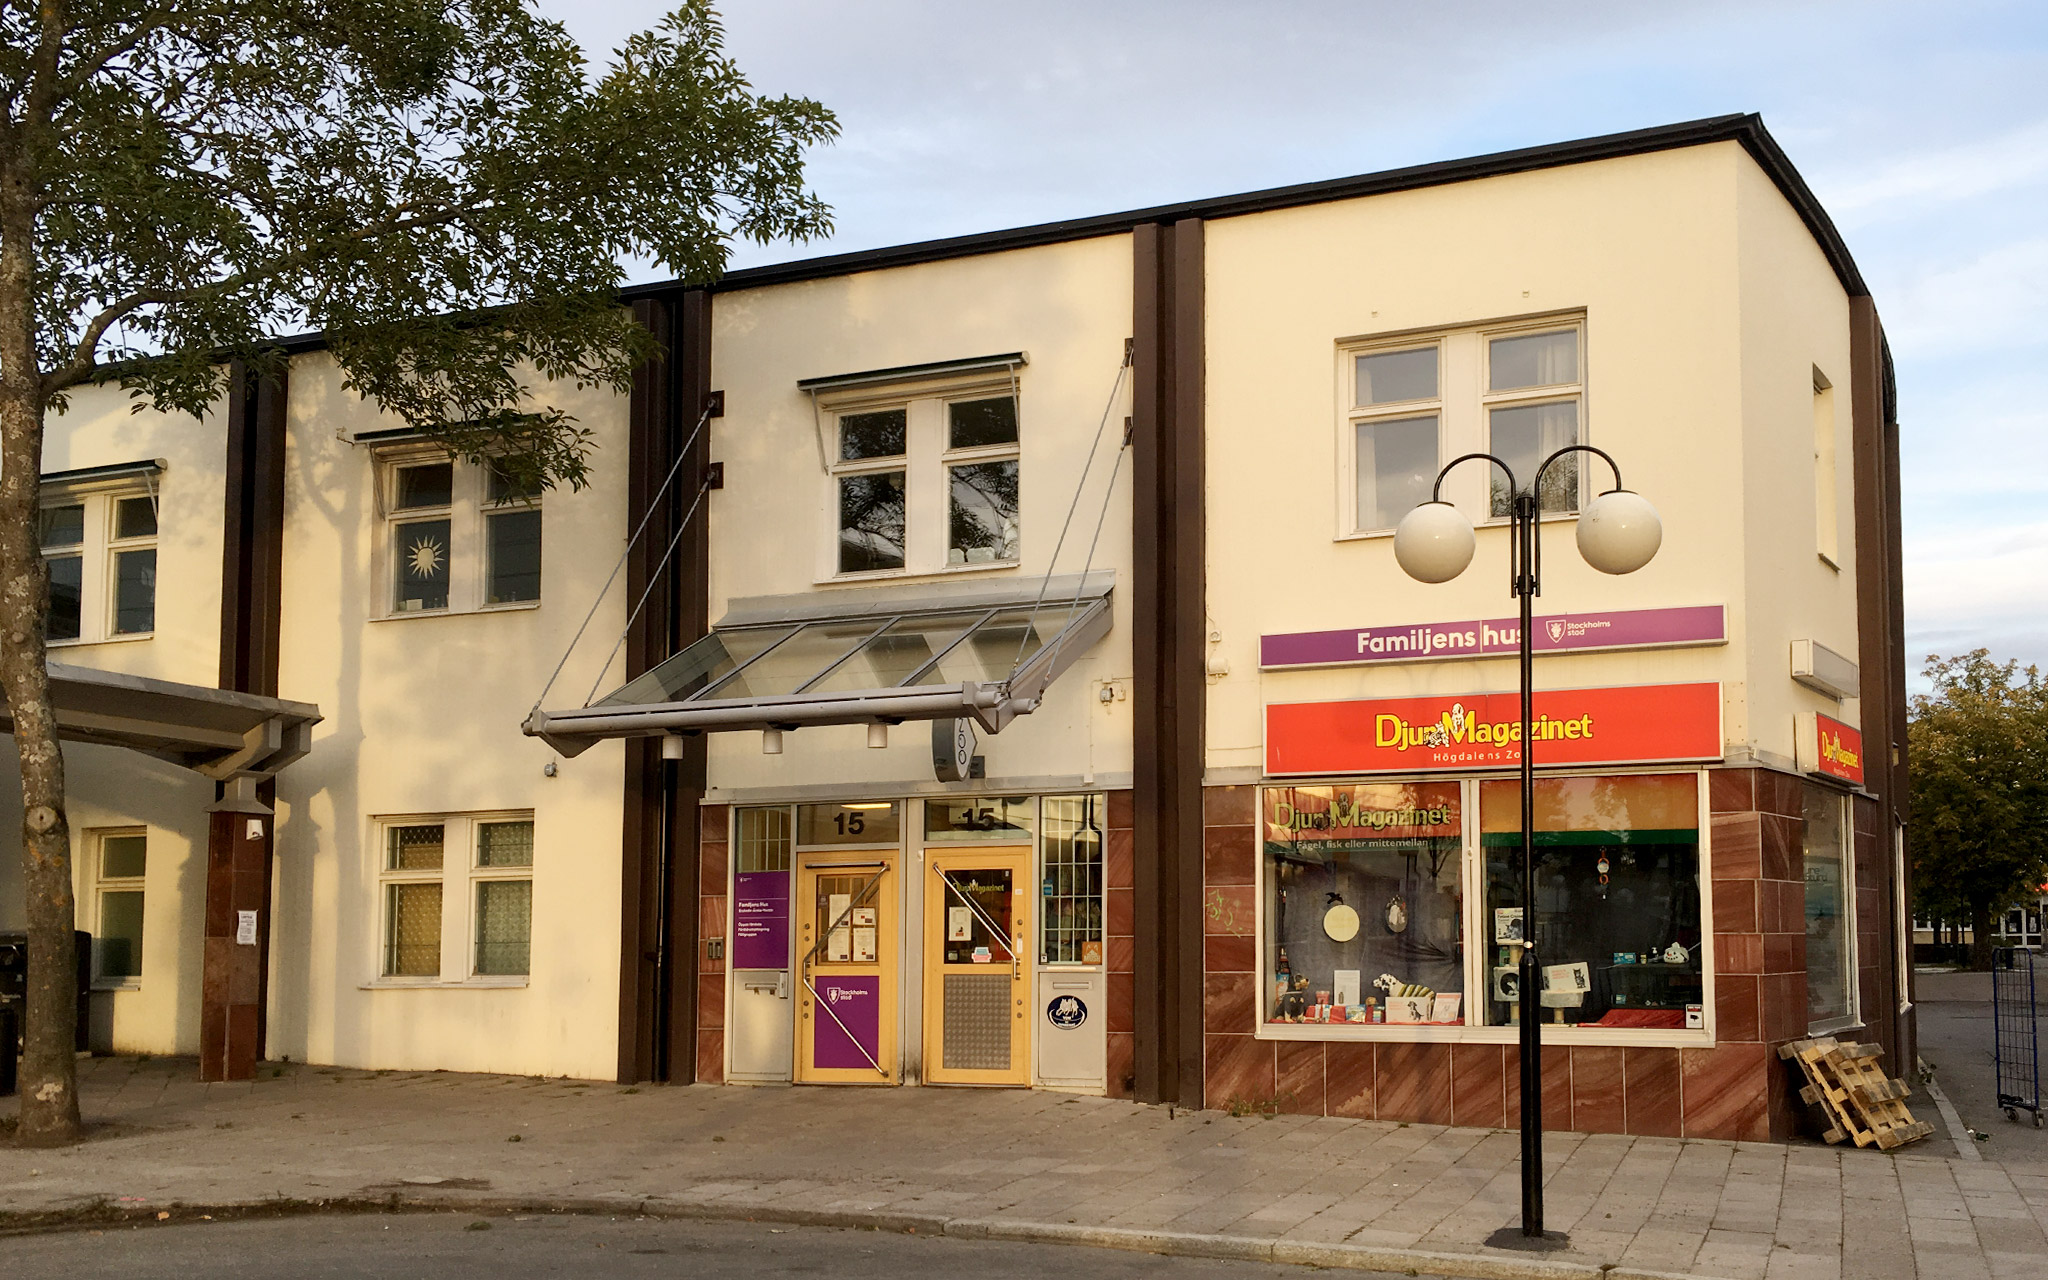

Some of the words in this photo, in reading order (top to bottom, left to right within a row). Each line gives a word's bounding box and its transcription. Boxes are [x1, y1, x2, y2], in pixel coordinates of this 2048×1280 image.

[1566, 620, 1612, 630] Stockholms
[1357, 628, 1477, 655] Familjens
[1433, 751, 1501, 763] Högdalens
[833, 811, 865, 836] 15
[962, 807, 995, 830] 15
[1326, 840, 1343, 849] fisk
[1344, 840, 1367, 849] eller
[1368, 839, 1429, 849] mittemellan
